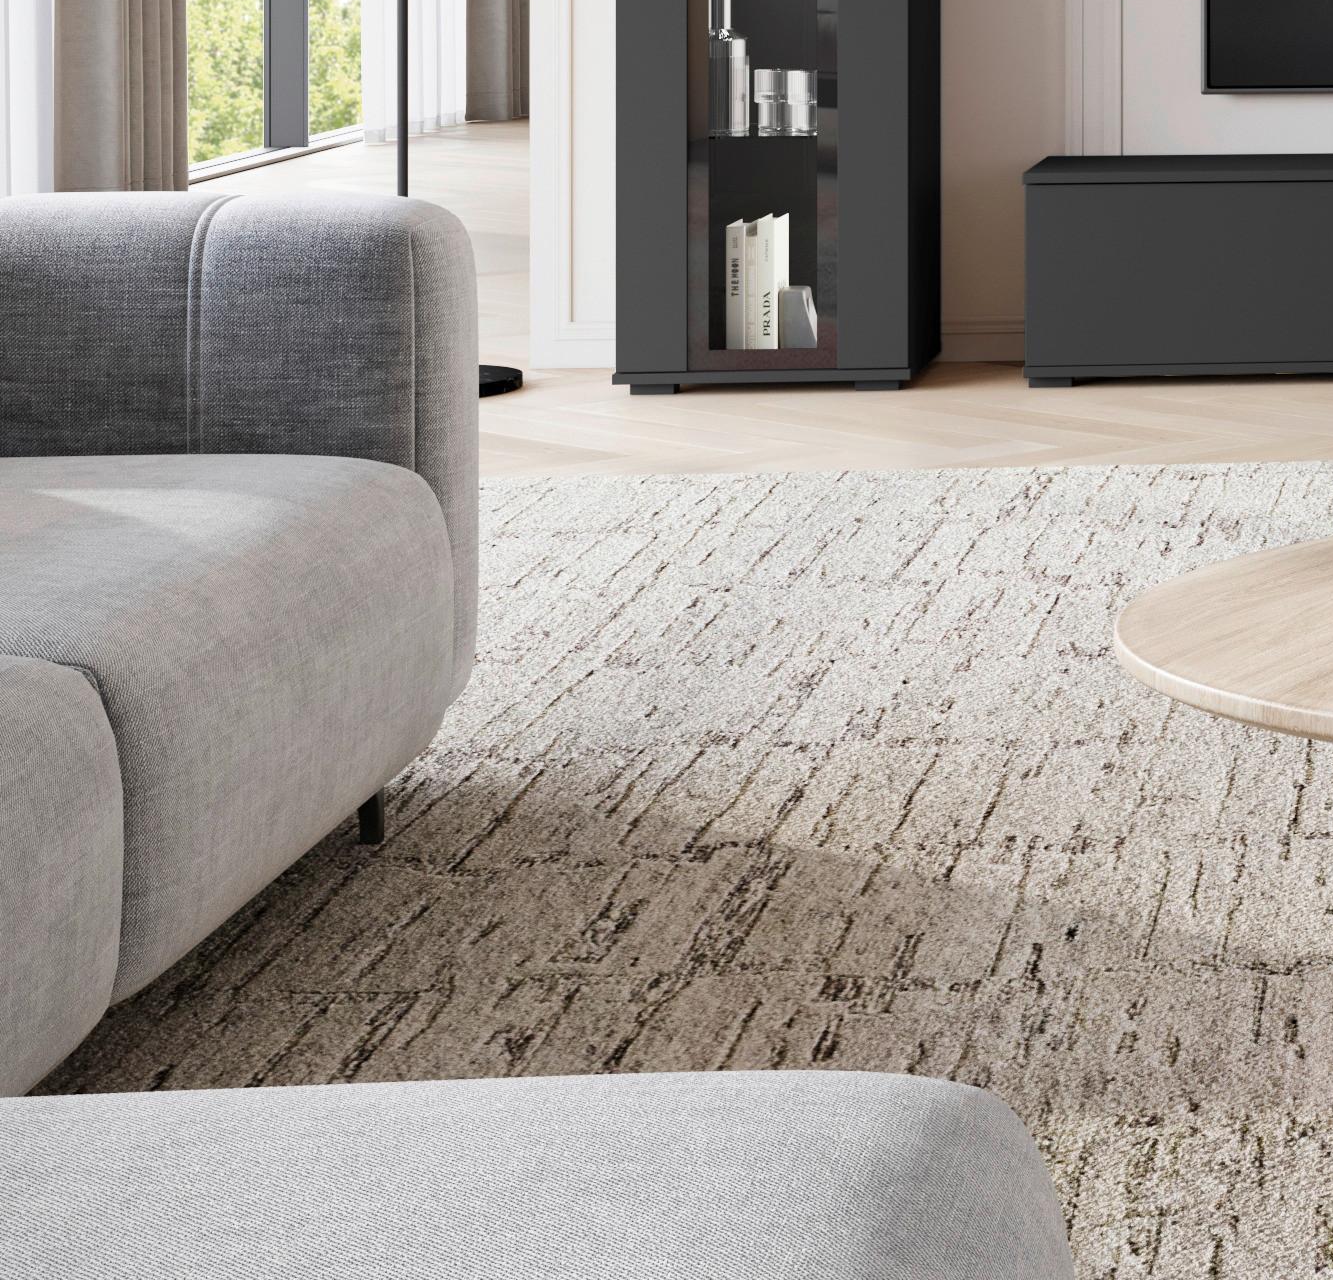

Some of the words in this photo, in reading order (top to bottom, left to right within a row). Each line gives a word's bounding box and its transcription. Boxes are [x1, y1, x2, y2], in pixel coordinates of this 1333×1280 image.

[731, 257, 740, 278] MOON
[731, 280, 740, 297] THE
[763, 291, 771, 336] PRADA
